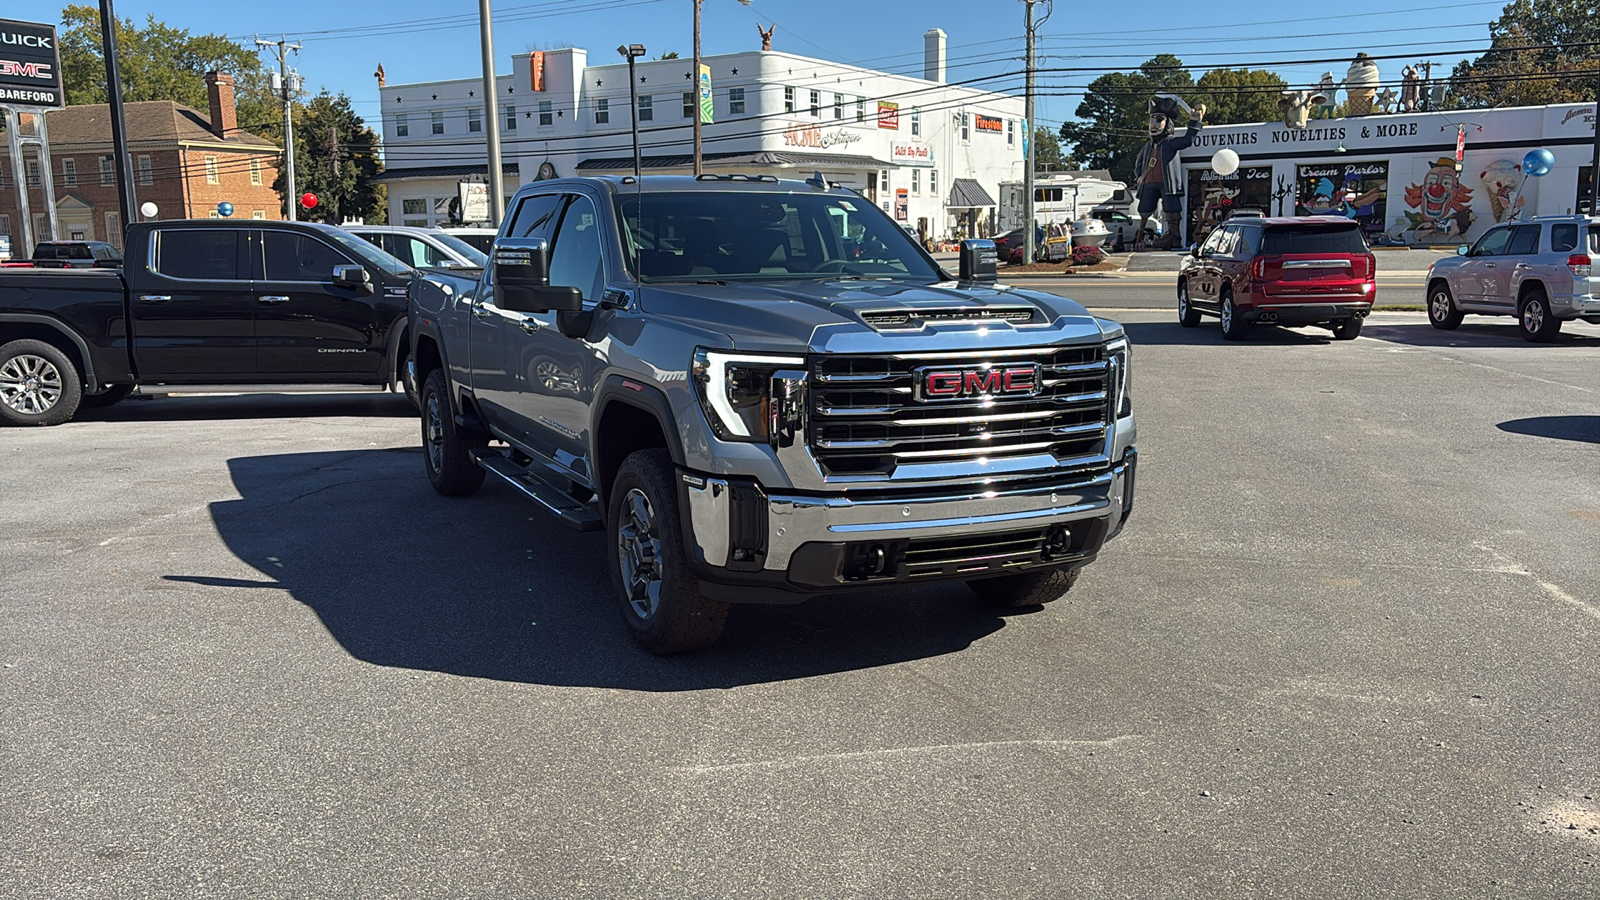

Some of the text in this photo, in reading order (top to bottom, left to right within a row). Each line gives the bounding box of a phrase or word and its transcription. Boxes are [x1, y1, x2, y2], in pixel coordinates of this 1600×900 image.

[0, 32, 52, 48] UICK
[0, 89, 54, 103] BAREFORD
[975, 114, 1002, 131] Firestone
[783, 122, 821, 147] ACME
[1192, 122, 1418, 147] OUVENIRS NOVELTIES & MORE
[1246, 168, 1270, 179] Ice
[1300, 166, 1338, 178] Cream
[1344, 164, 1386, 176] Parlor
[926, 368, 1035, 396] GMC
